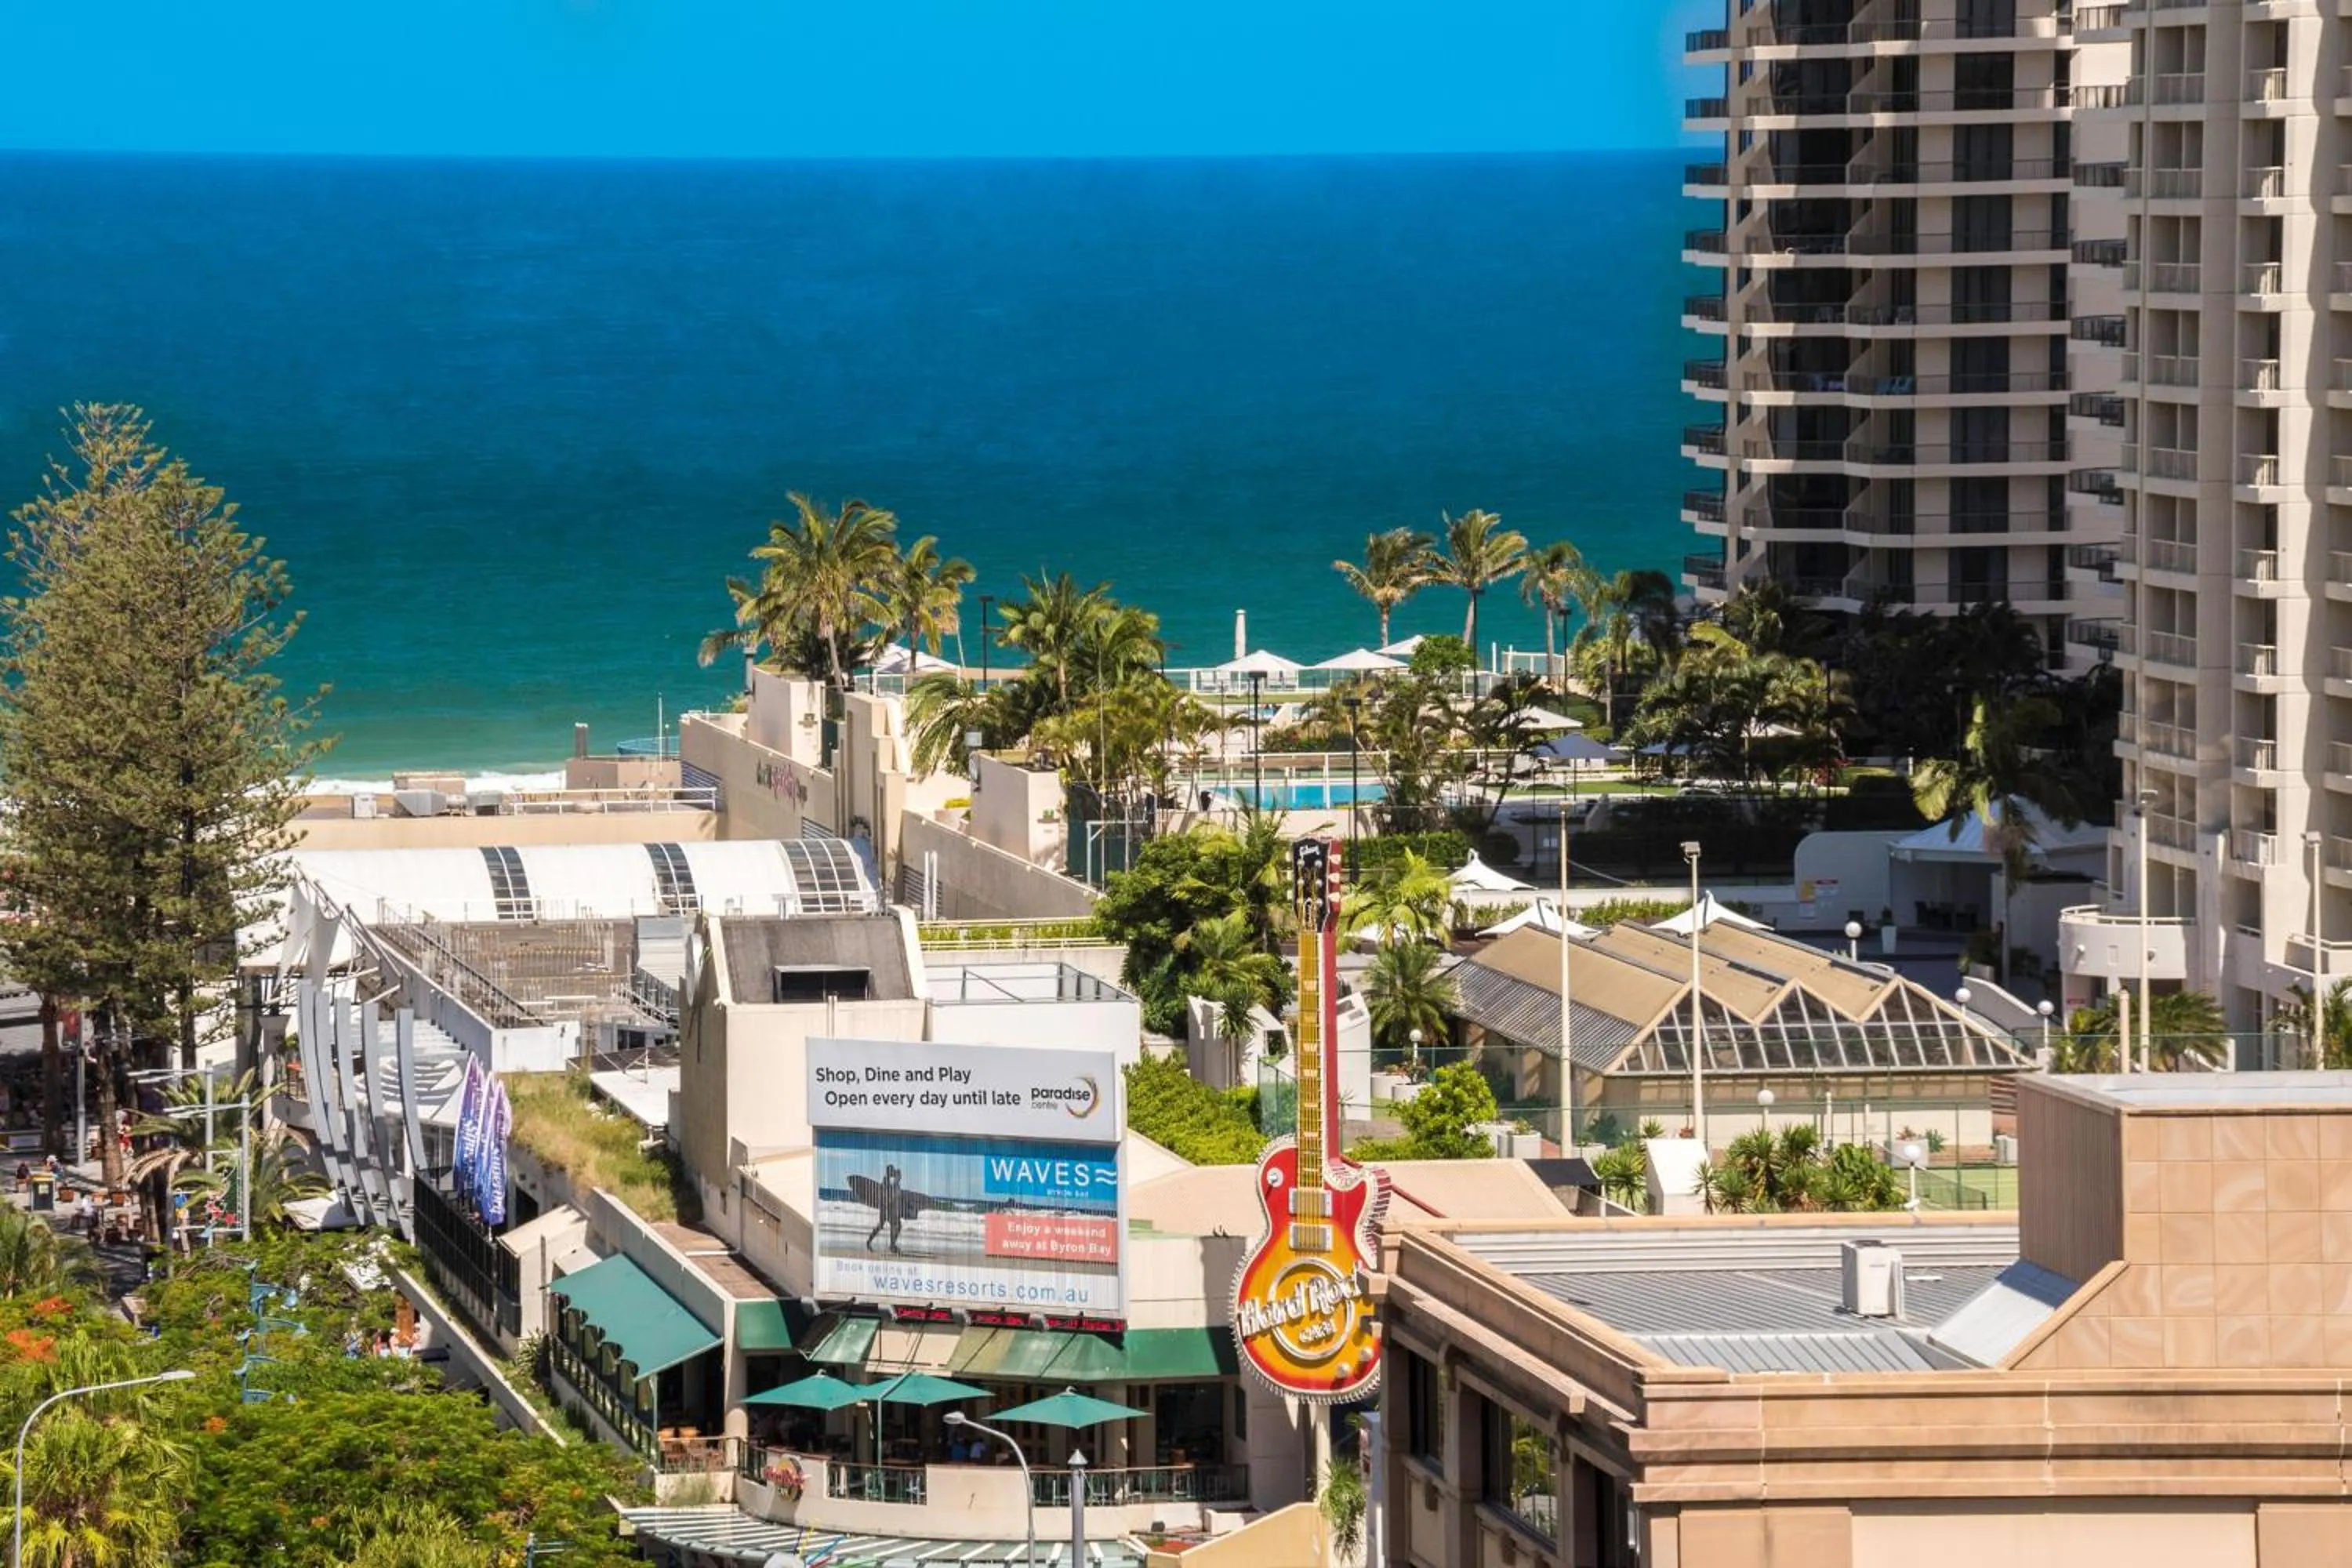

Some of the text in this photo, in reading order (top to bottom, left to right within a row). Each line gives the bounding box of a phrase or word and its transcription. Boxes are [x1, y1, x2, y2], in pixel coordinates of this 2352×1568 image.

[815, 1067, 971, 1084] Shop, Dine and Play
[825, 1090, 1022, 1108] Open every day until late
[1031, 1087, 1091, 1101] paradise
[990, 1158, 1090, 1187] WAVES
[1007, 1221, 1106, 1239] Enjoy a weekend
[1003, 1240, 1032, 1251] away
[1036, 1240, 1047, 1251] at
[1050, 1240, 1085, 1254] Byron
[873, 1275, 1088, 1302] wavesresorts.com.au
[1241, 1279, 1306, 1338] Hard
